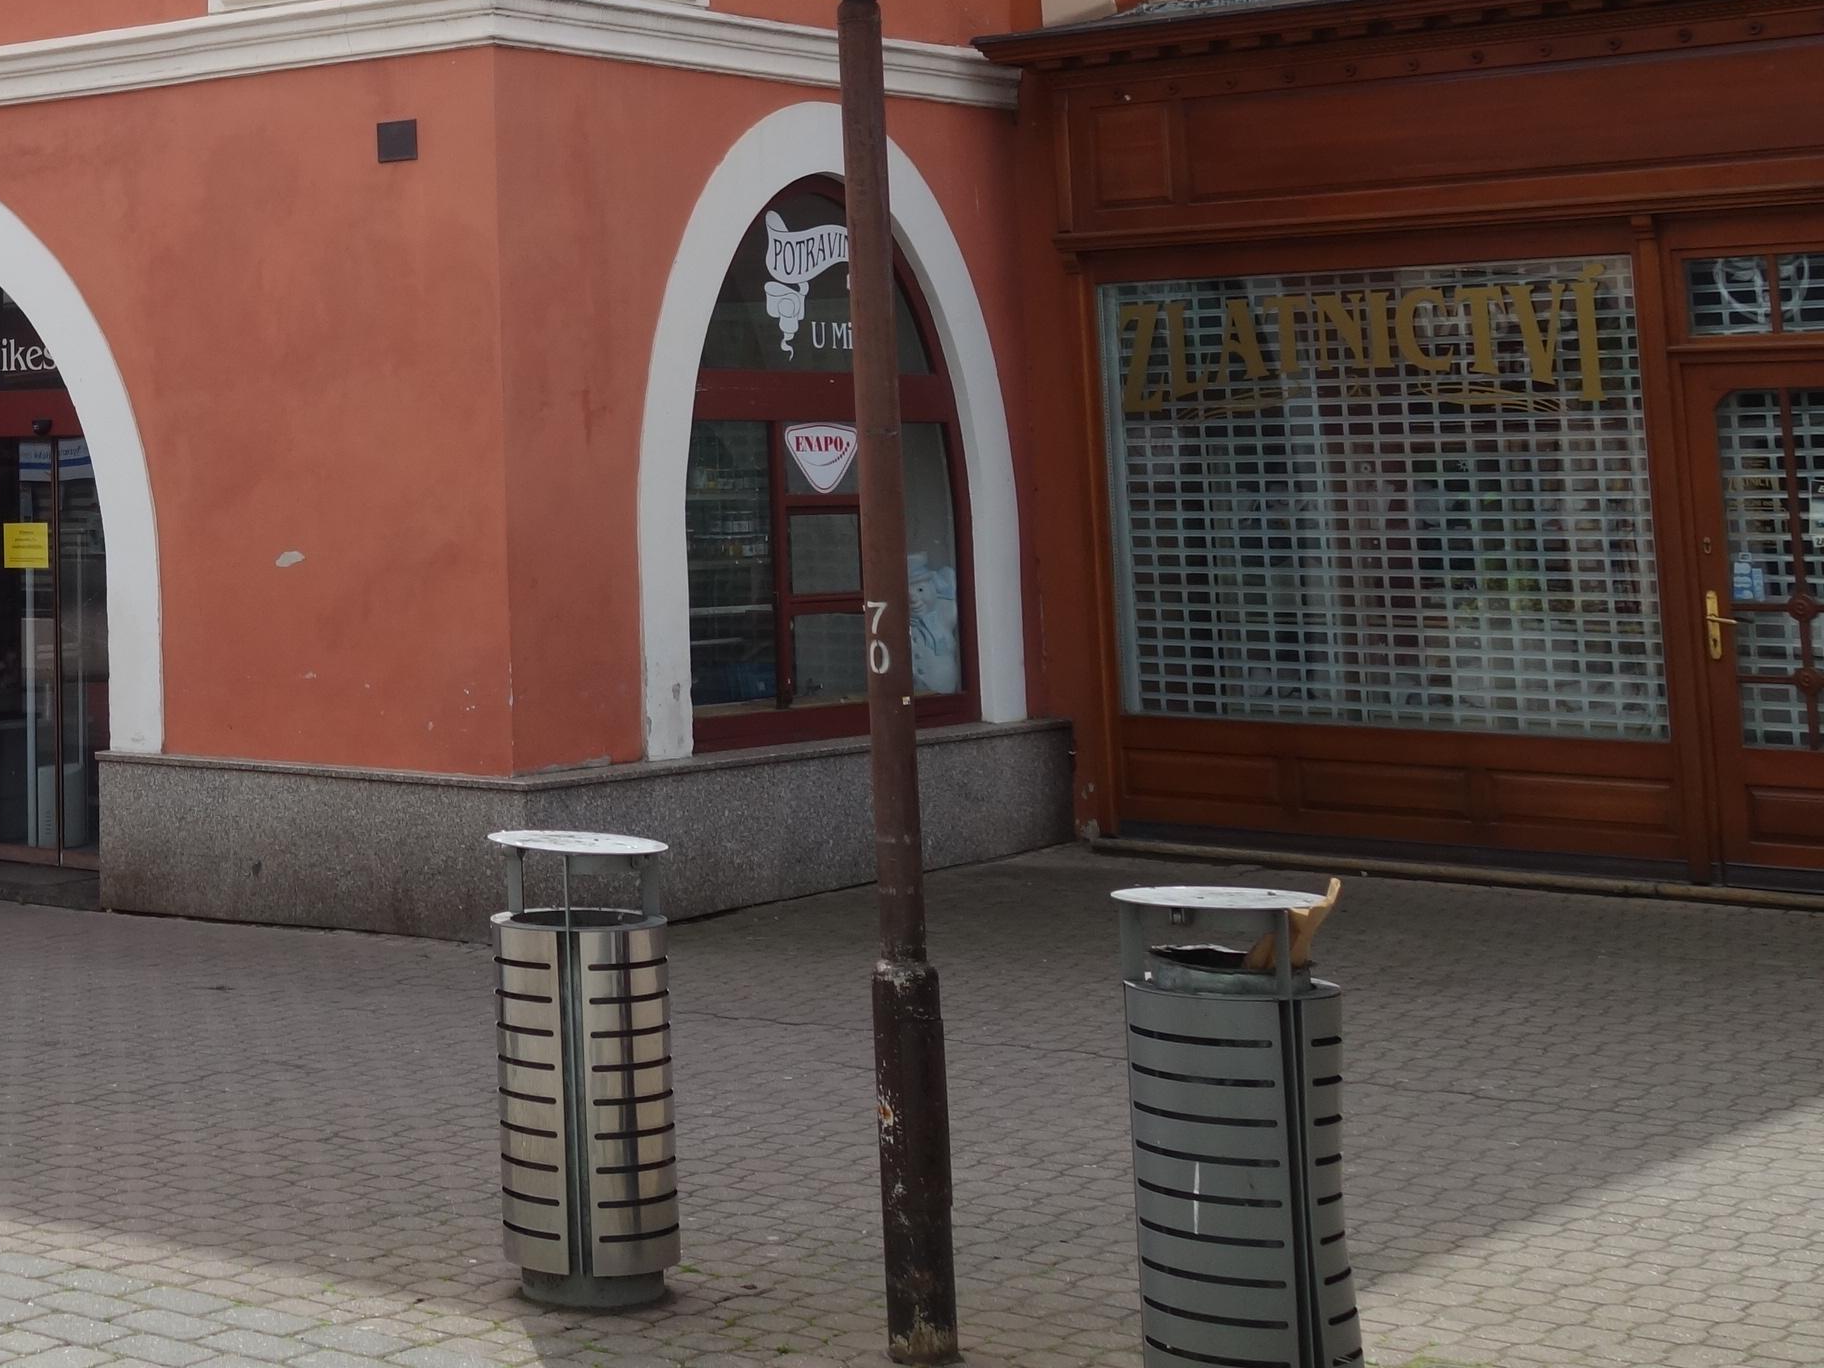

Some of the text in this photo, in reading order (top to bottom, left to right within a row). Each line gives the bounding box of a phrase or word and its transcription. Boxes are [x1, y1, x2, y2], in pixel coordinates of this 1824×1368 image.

[773, 232, 850, 276] POTRAVI
[811, 321, 826, 349] U
[1118, 263, 1608, 414] ZLATNICTVÍ
[794, 435, 844, 452] ENAPO
